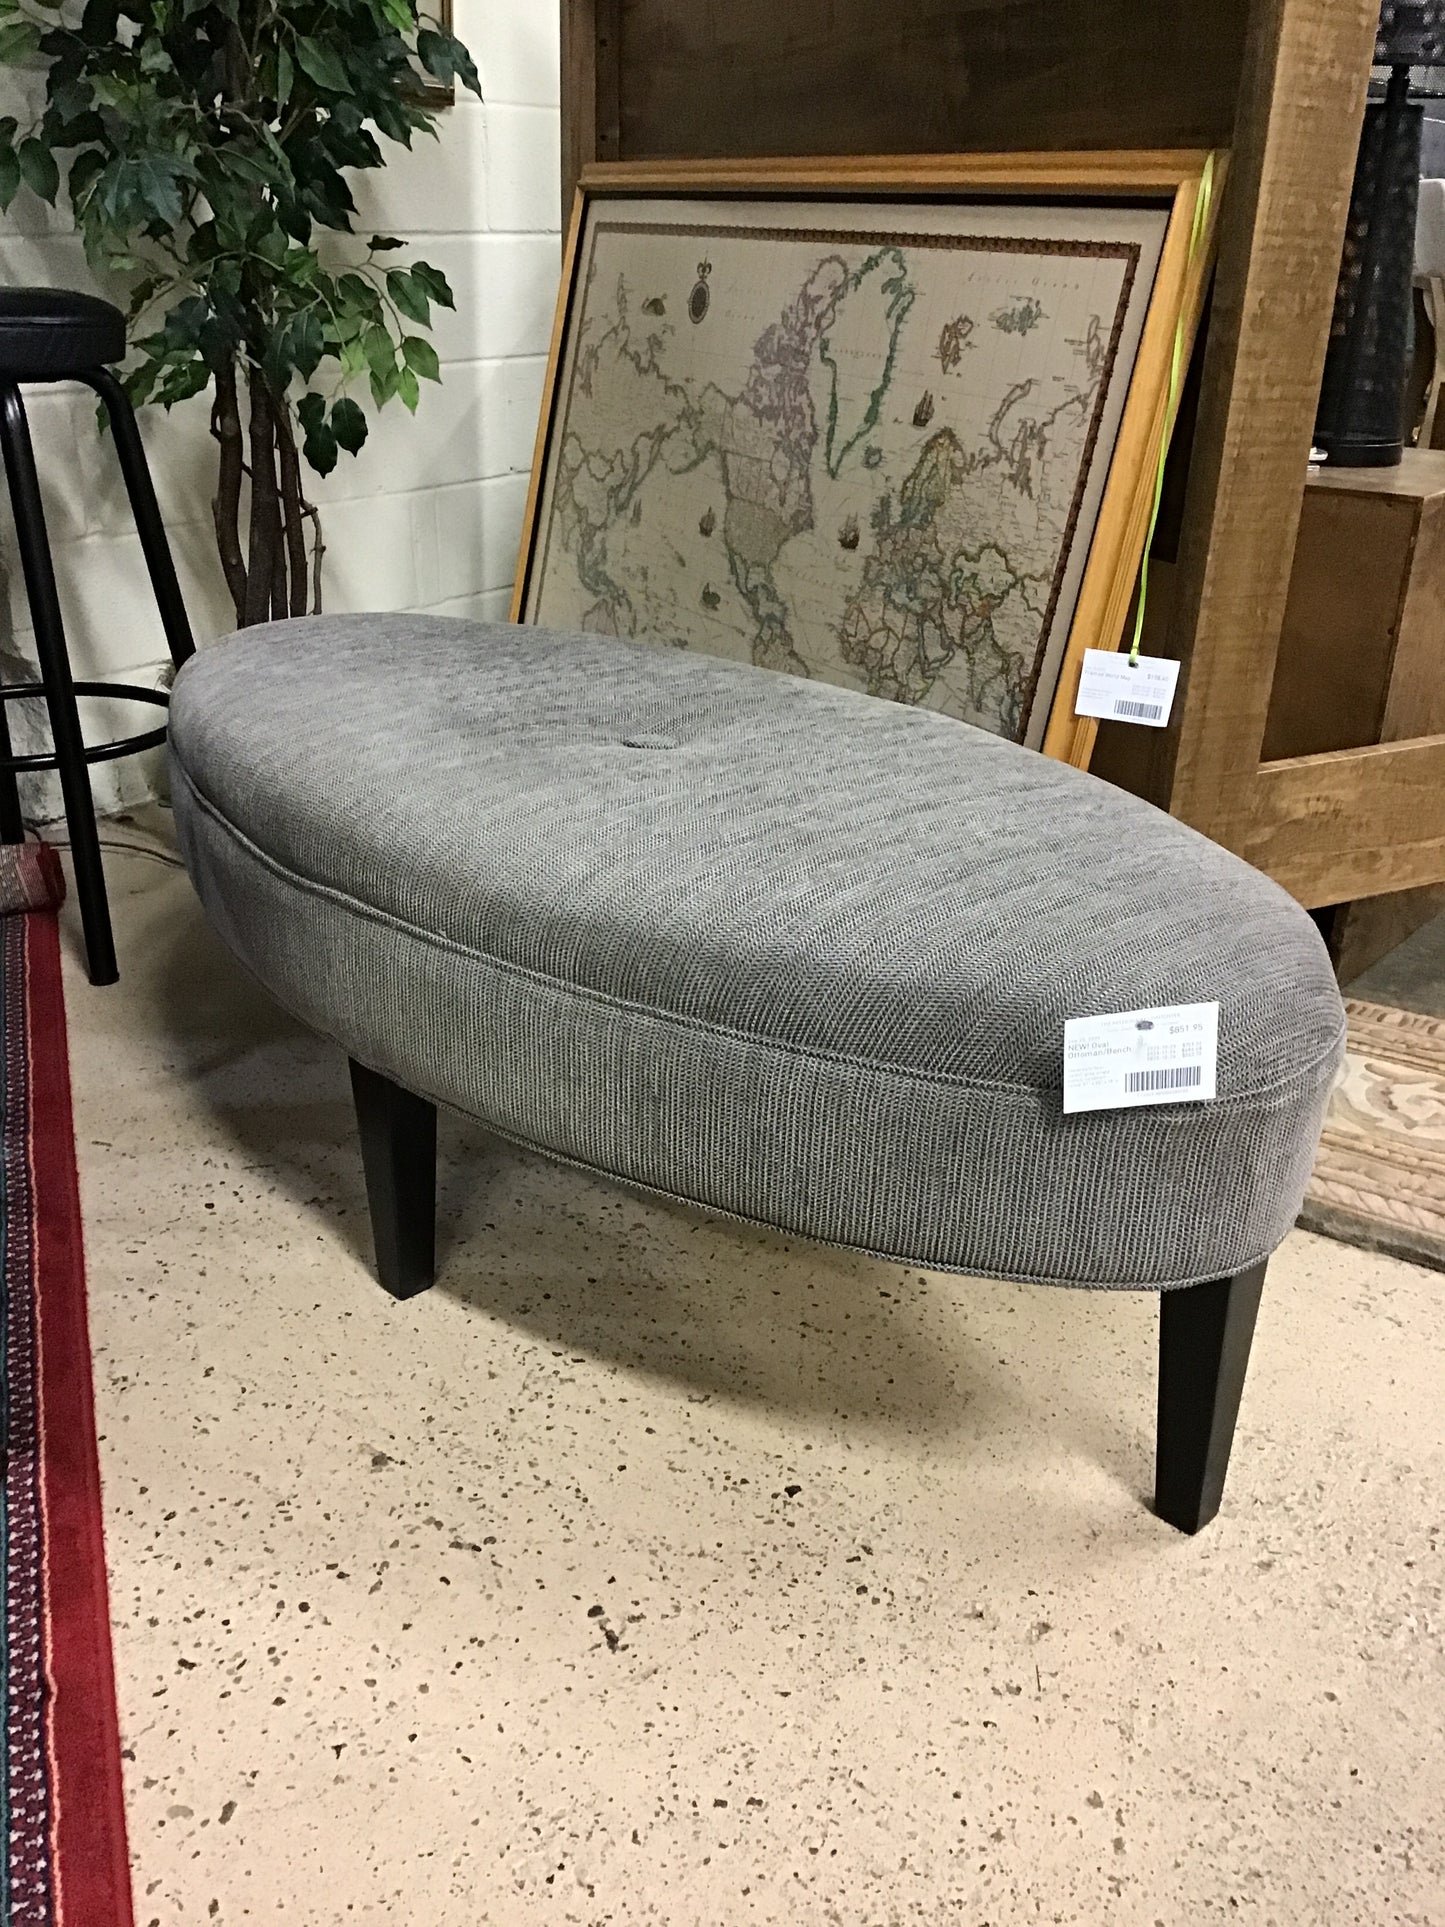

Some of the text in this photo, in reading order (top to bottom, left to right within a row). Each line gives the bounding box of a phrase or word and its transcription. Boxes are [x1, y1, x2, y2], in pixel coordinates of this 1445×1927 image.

[1169, 1023, 1203, 1035] $851.95
[1067, 1045, 1132, 1059] Ottoman/Bench
[1068, 1041, 1109, 1052] NEW! Oval
